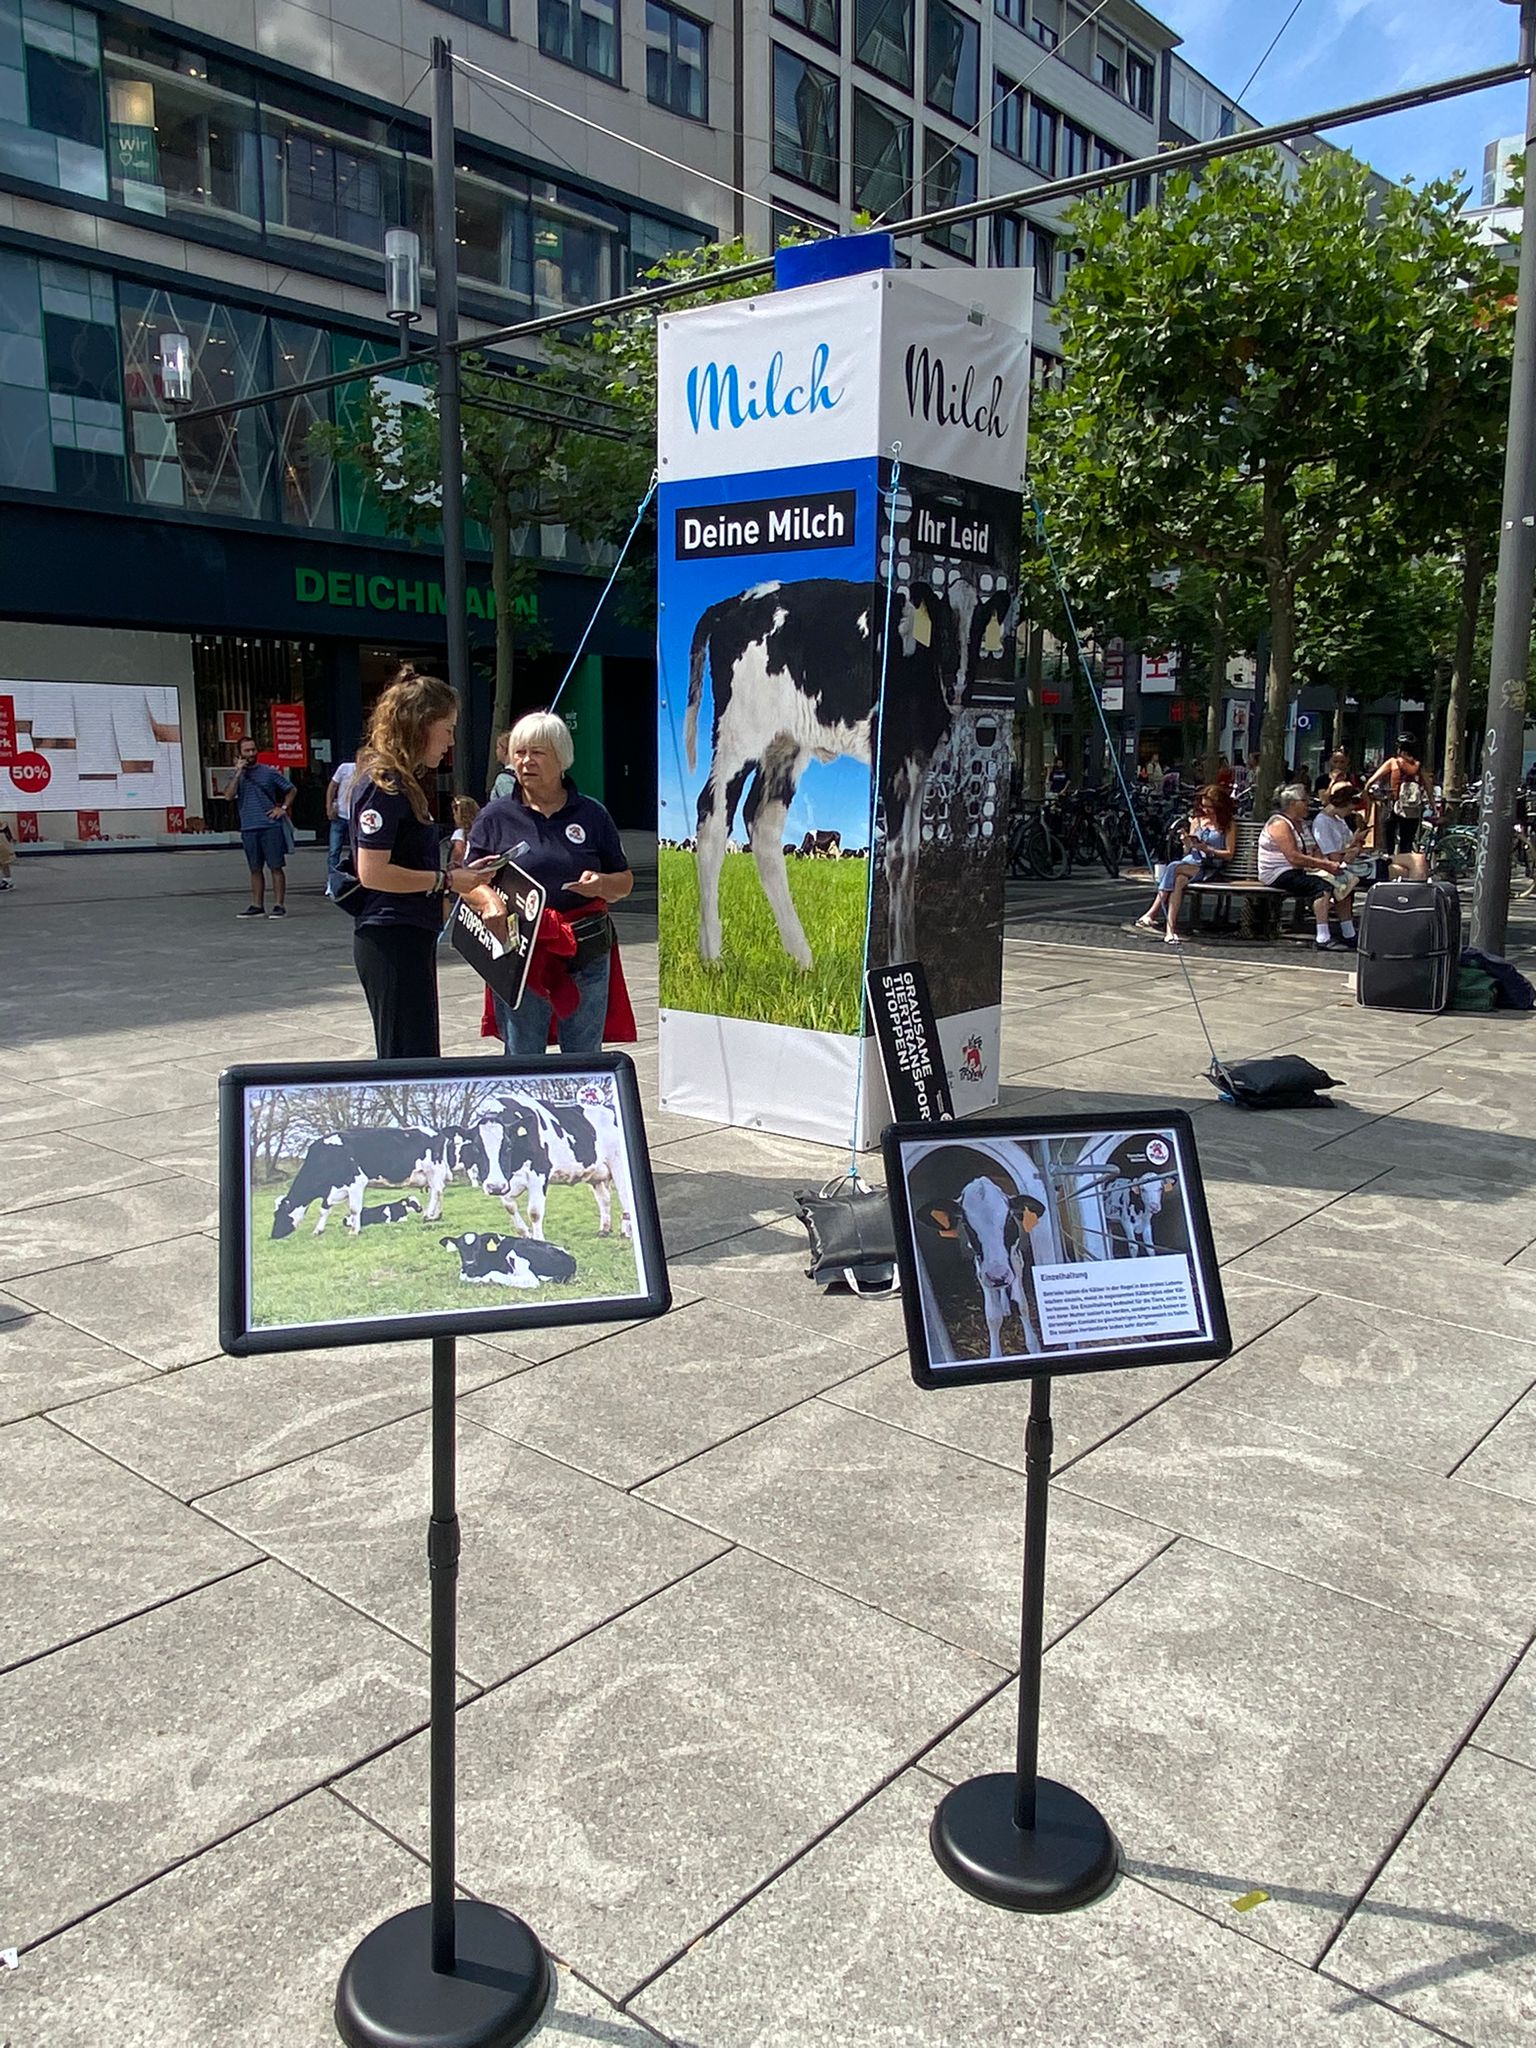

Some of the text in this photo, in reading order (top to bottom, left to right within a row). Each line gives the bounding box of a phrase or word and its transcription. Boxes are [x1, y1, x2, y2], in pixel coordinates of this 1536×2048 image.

[686, 343, 844, 435] Milch
[905, 344, 1008, 438] Milch
[684, 504, 844, 550] Deine Milch
[918, 509, 989, 554] Ihr Leid
[12, 765, 49, 780] 50%
[882, 976, 906, 1072] STOPPEN!
[893, 973, 933, 1122] TIERTRANSPOR
[903, 972, 933, 1078] GRAUSAME
